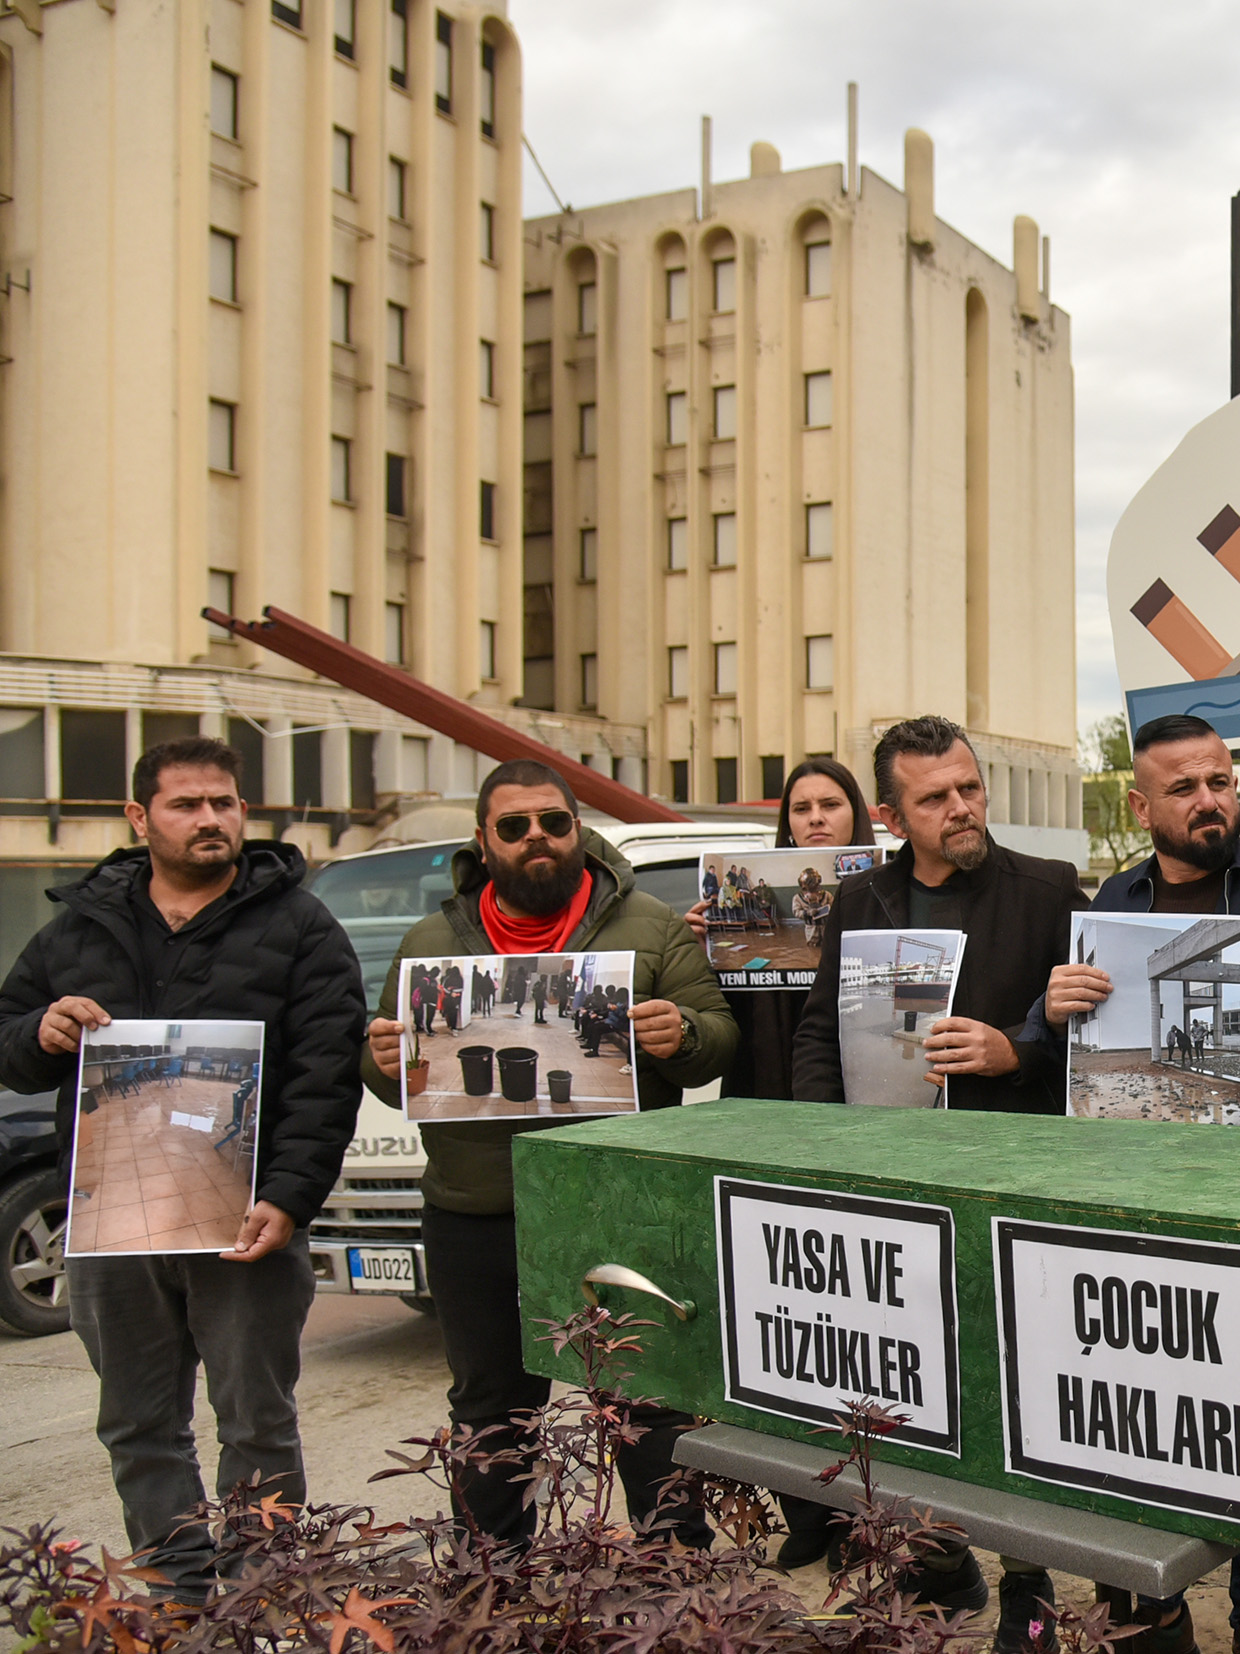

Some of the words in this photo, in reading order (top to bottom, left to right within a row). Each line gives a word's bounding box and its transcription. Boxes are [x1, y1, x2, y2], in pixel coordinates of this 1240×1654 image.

[719, 972, 747, 986] YENİ
[750, 971, 784, 985] NESİL
[787, 971, 818, 985] MOD
[345, 1136, 418, 1157] SUZU
[762, 1222, 851, 1299] YASA
[860, 1237, 905, 1309] VE
[755, 1304, 924, 1408] TÜZÜKLER
[1072, 1272, 1223, 1365] ÇOCUK
